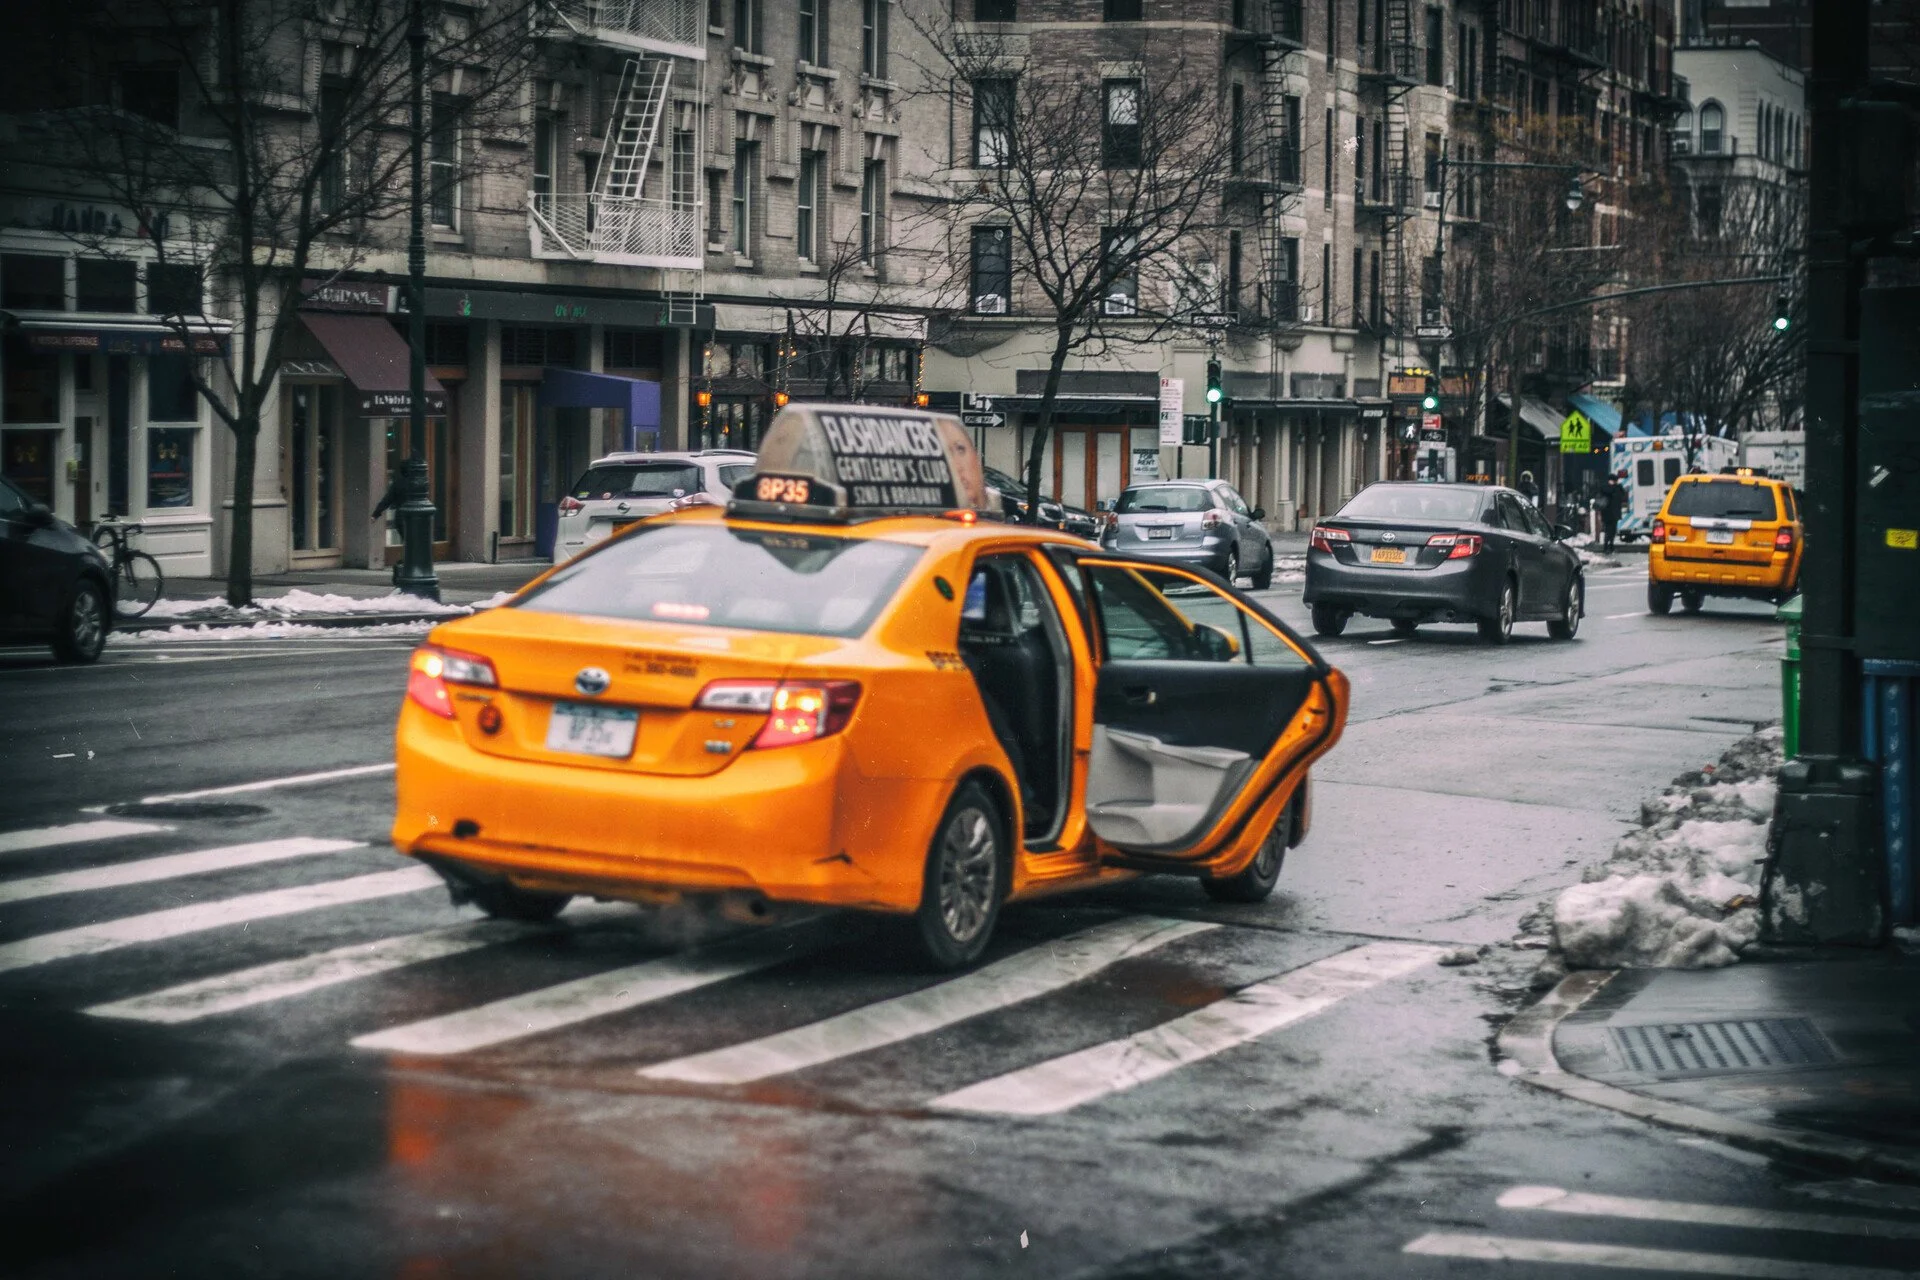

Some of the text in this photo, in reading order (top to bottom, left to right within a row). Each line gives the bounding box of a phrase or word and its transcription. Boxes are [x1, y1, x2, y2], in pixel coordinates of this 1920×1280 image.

[820, 415, 944, 457] FLASHDANCERS
[836, 456, 950, 484] GENTLEMEN'S CLUB
[757, 477, 809, 503] 8P35
